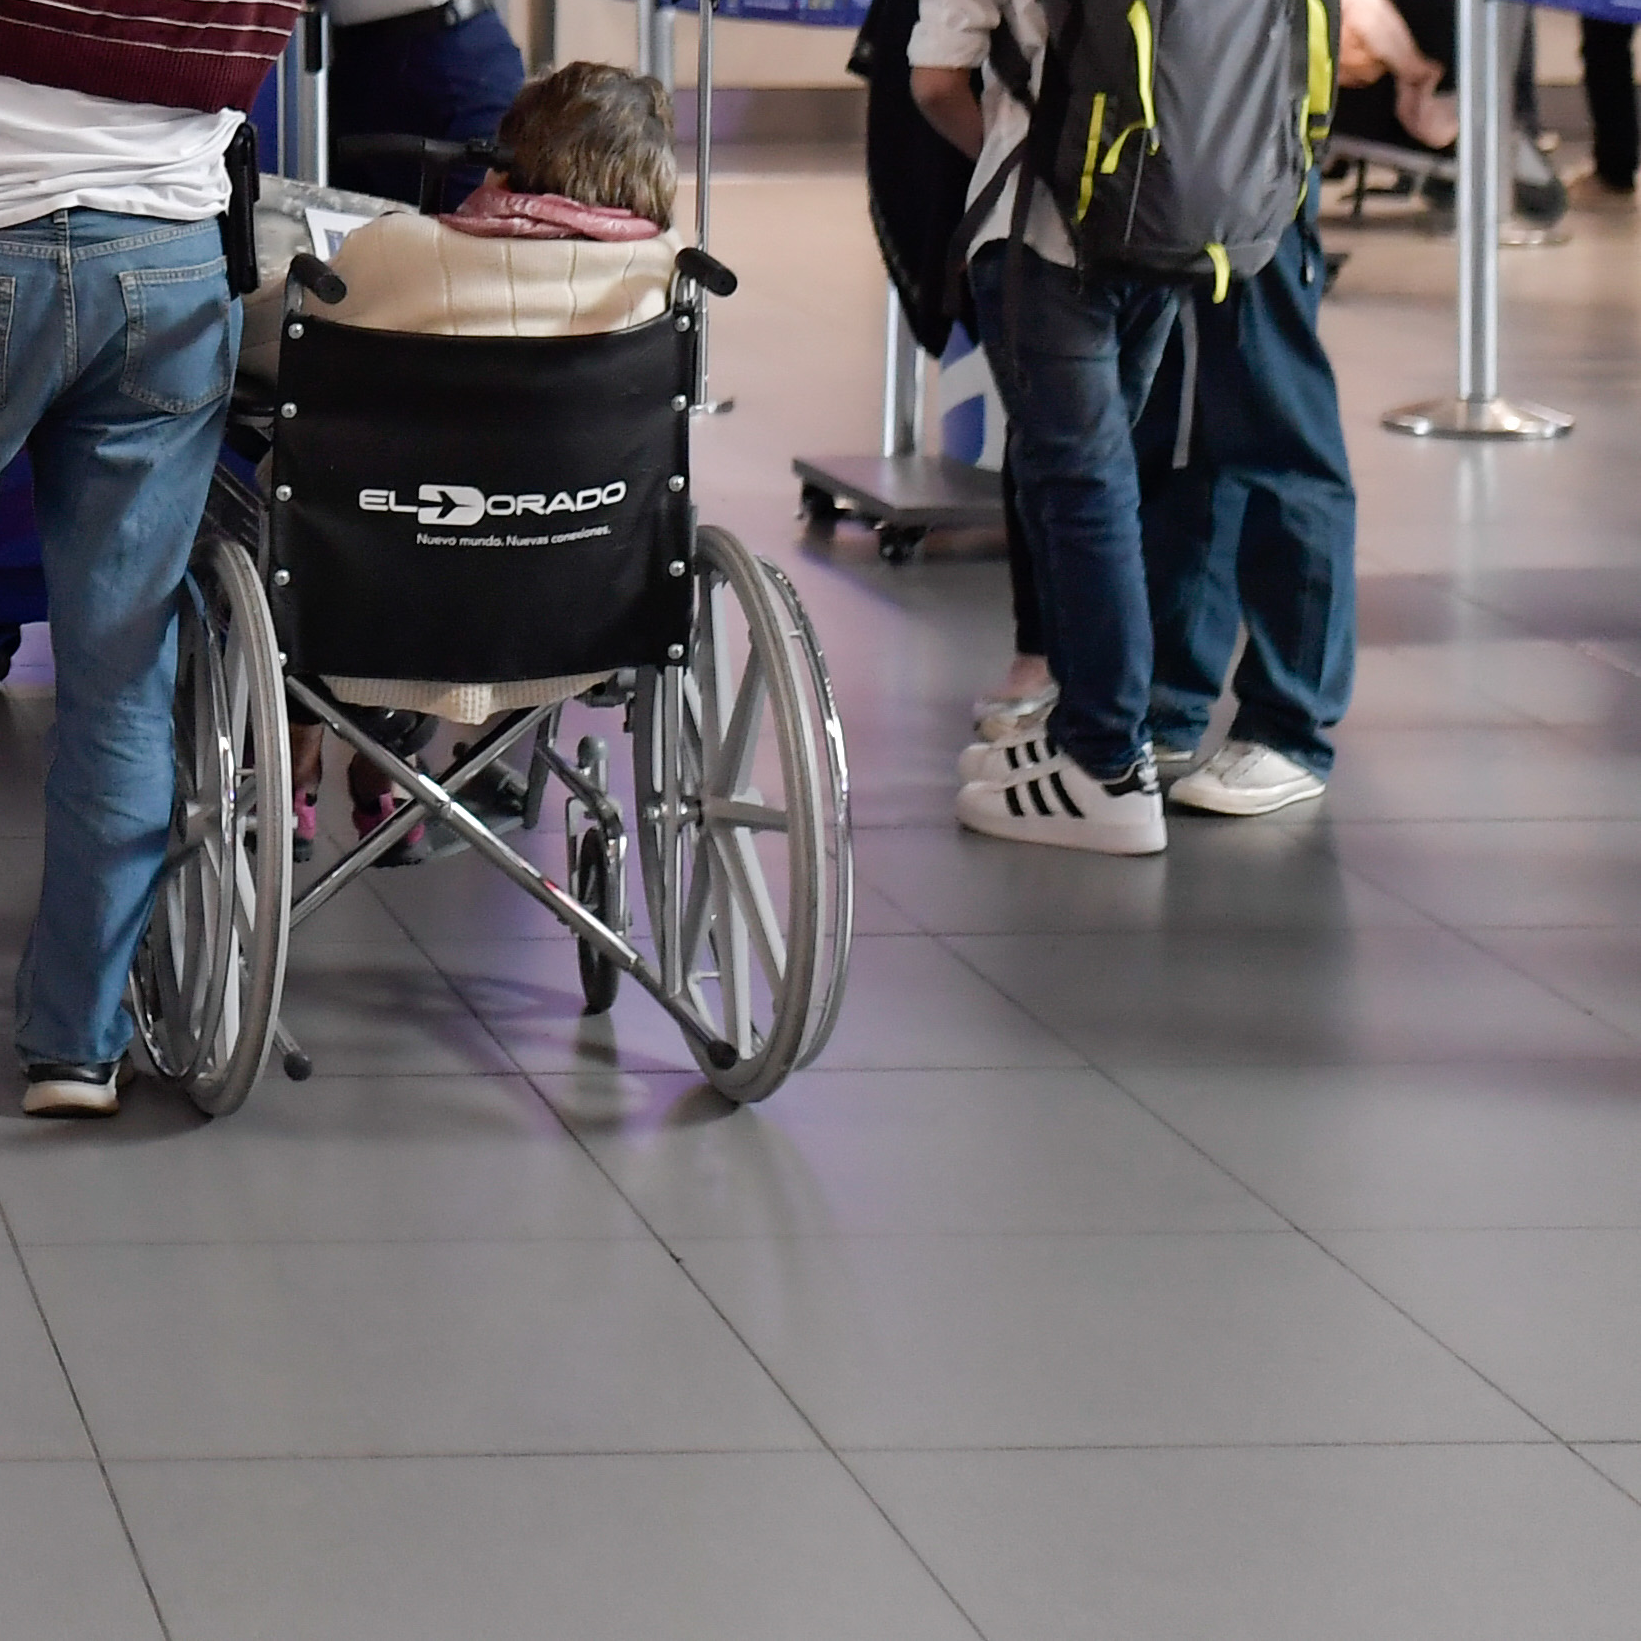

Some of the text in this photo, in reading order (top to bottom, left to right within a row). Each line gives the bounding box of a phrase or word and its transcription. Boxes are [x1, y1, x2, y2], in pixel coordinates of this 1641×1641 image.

[359, 489, 417, 512] EL
[417, 524, 612, 547] Nuevo mundo. Nuevas conexiones.
